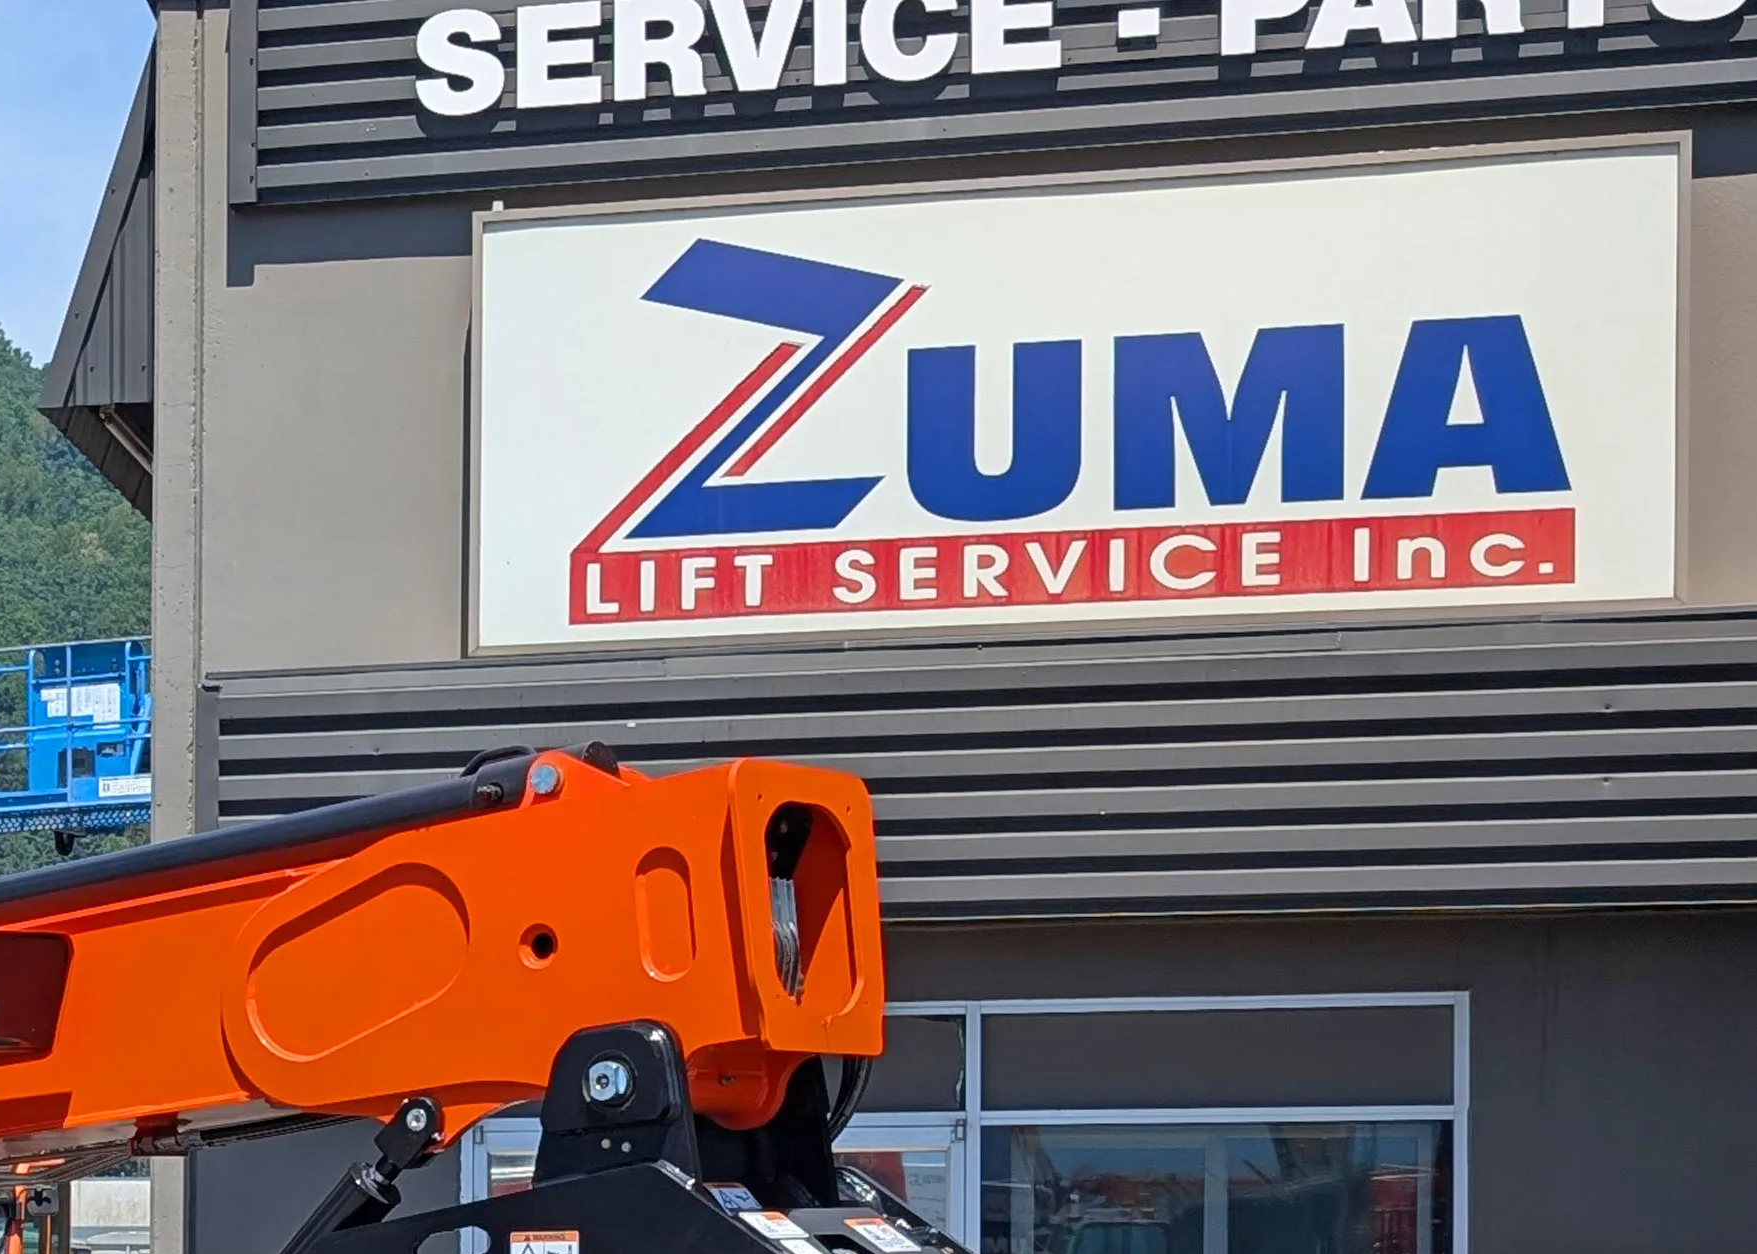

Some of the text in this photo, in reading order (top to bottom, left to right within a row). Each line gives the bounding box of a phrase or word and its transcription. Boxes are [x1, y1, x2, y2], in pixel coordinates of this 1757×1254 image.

[415, 0, 1062, 115] SERVICE
[589, 238, 1572, 541] ZUMA
[585, 521, 1556, 615] LIFT SERVICE Inc.
